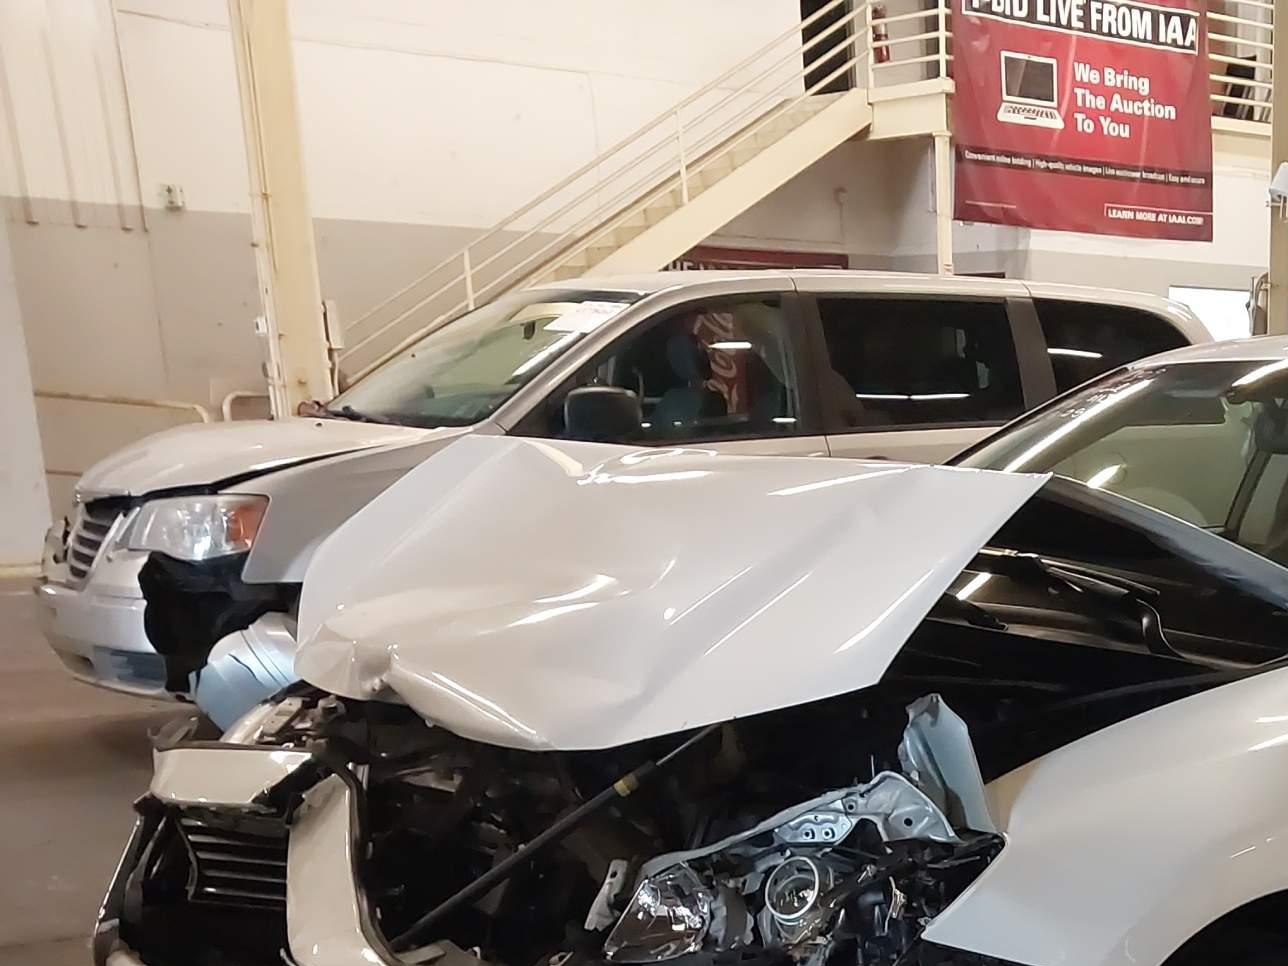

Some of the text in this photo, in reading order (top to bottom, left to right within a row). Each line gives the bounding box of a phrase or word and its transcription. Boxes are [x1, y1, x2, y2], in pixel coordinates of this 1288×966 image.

[1036, 0, 1085, 29] LIVE
[1090, 1, 1153, 40] FROM
[1159, 13, 1197, 46] IAA
[1073, 61, 1150, 96] We Bring
[1073, 87, 1176, 120] The Auction
[1073, 112, 1130, 138] To You
[1108, 208, 1134, 219] LEARN
[1135, 211, 1157, 222] MORE
[1158, 213, 1168, 222] AT
